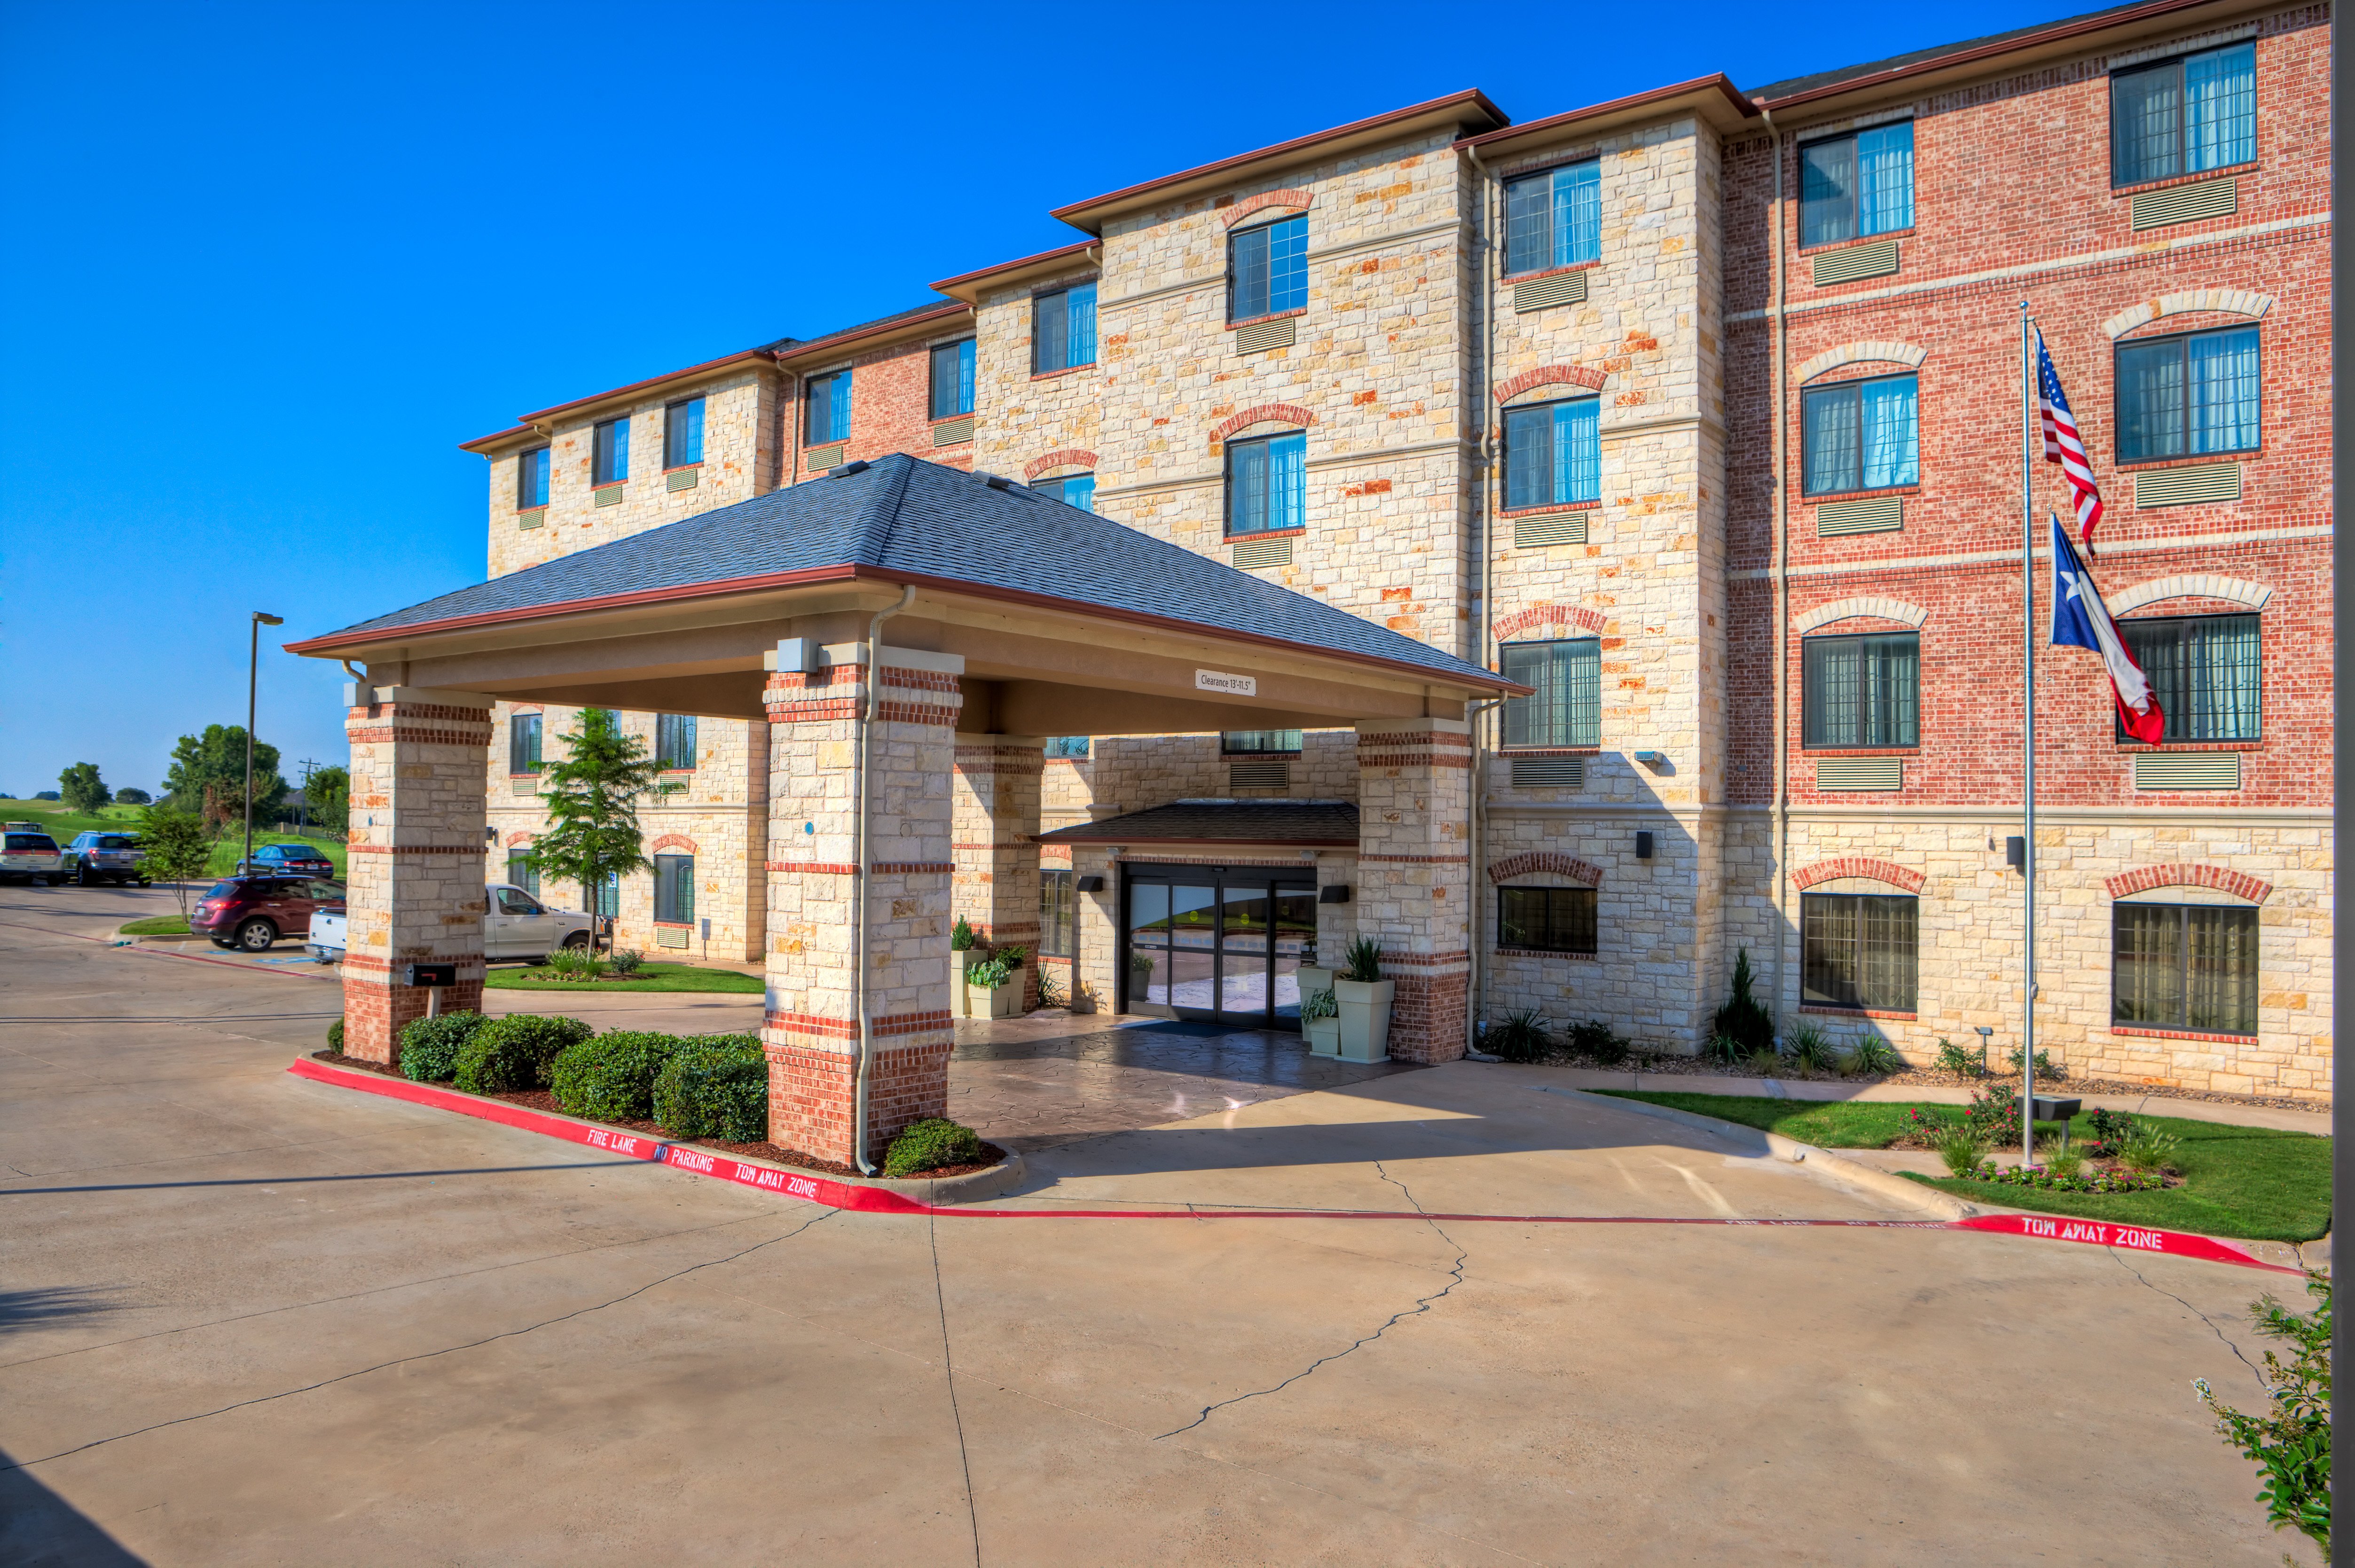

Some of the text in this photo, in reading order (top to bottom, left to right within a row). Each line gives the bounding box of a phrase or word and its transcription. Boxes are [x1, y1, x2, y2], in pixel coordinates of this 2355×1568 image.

[1201, 674, 1251, 690] Clearance 13'-11.5"
[587, 1129, 817, 1198] FIRE LANE NO PARKING TOW AWAY ZONE
[2022, 1217, 2056, 1236] TOW
[2062, 1222, 2106, 1242] AWAY
[2116, 1228, 2162, 1249] ZONE
